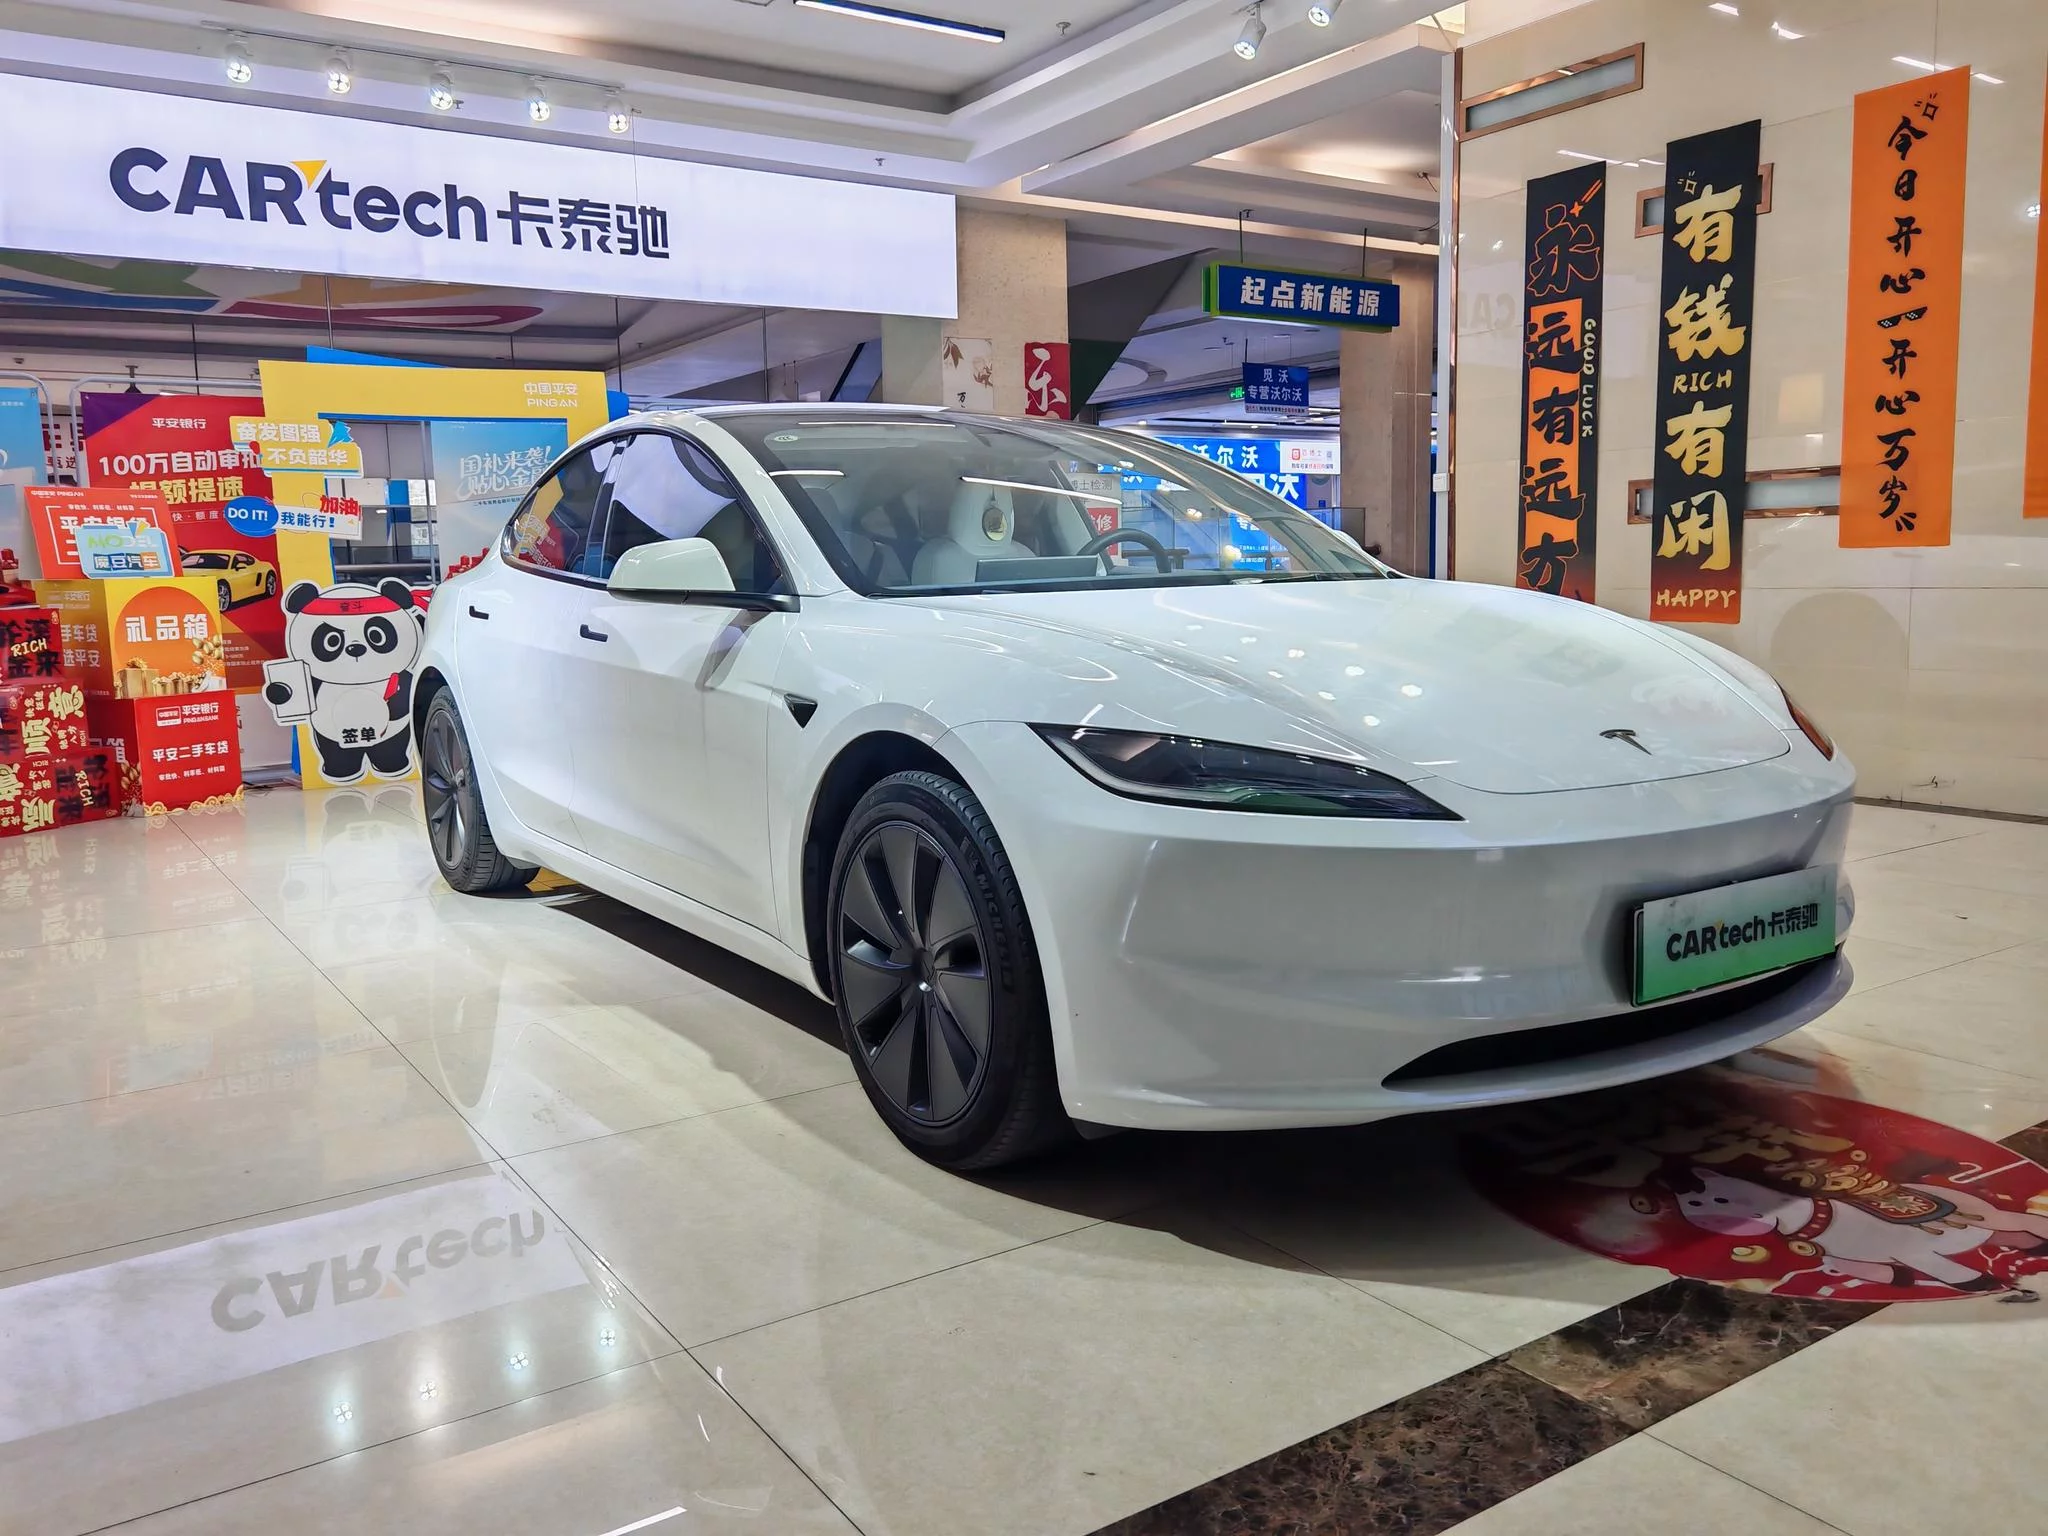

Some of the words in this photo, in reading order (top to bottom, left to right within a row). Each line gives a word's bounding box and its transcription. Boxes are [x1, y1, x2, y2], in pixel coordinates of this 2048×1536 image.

[109, 146, 488, 242] CARtech
[496, 190, 670, 259] 卡泰驰
[1664, 184, 1746, 362] 有钱
[1240, 276, 1381, 318] 起点新能源
[1582, 318, 1597, 376] GOOD
[524, 382, 578, 395] 中国平安
[1672, 369, 1732, 393] RICH
[1247, 385, 1303, 402] 专营沃尔沃
[1520, 203, 1601, 595] 永远有远方
[1581, 384, 1595, 437] LUCK
[152, 417, 207, 430] 平安银行
[236, 422, 321, 443] 奋发图强
[267, 447, 348, 466] 不负韶华
[1656, 400, 1733, 571] 有闲
[228, 507, 249, 519] DO
[251, 509, 268, 521] IT!
[281, 511, 335, 528] 我能行!
[340, 600, 364, 613] 奋斗
[1656, 588, 1737, 609] HAPPY
[125, 613, 208, 642] 礼品箱
[11, 638, 48, 657] RICH
[182, 702, 219, 716] 平安银行
[21, 717, 52, 755] 顺
[341, 727, 376, 744] 签单
[152, 740, 229, 762] 平安二手车贷
[75, 770, 94, 806] RICH
[21, 797, 56, 831] 顺
[1667, 916, 1766, 962] CARtech
[1768, 903, 1818, 937] 卡泰驰
